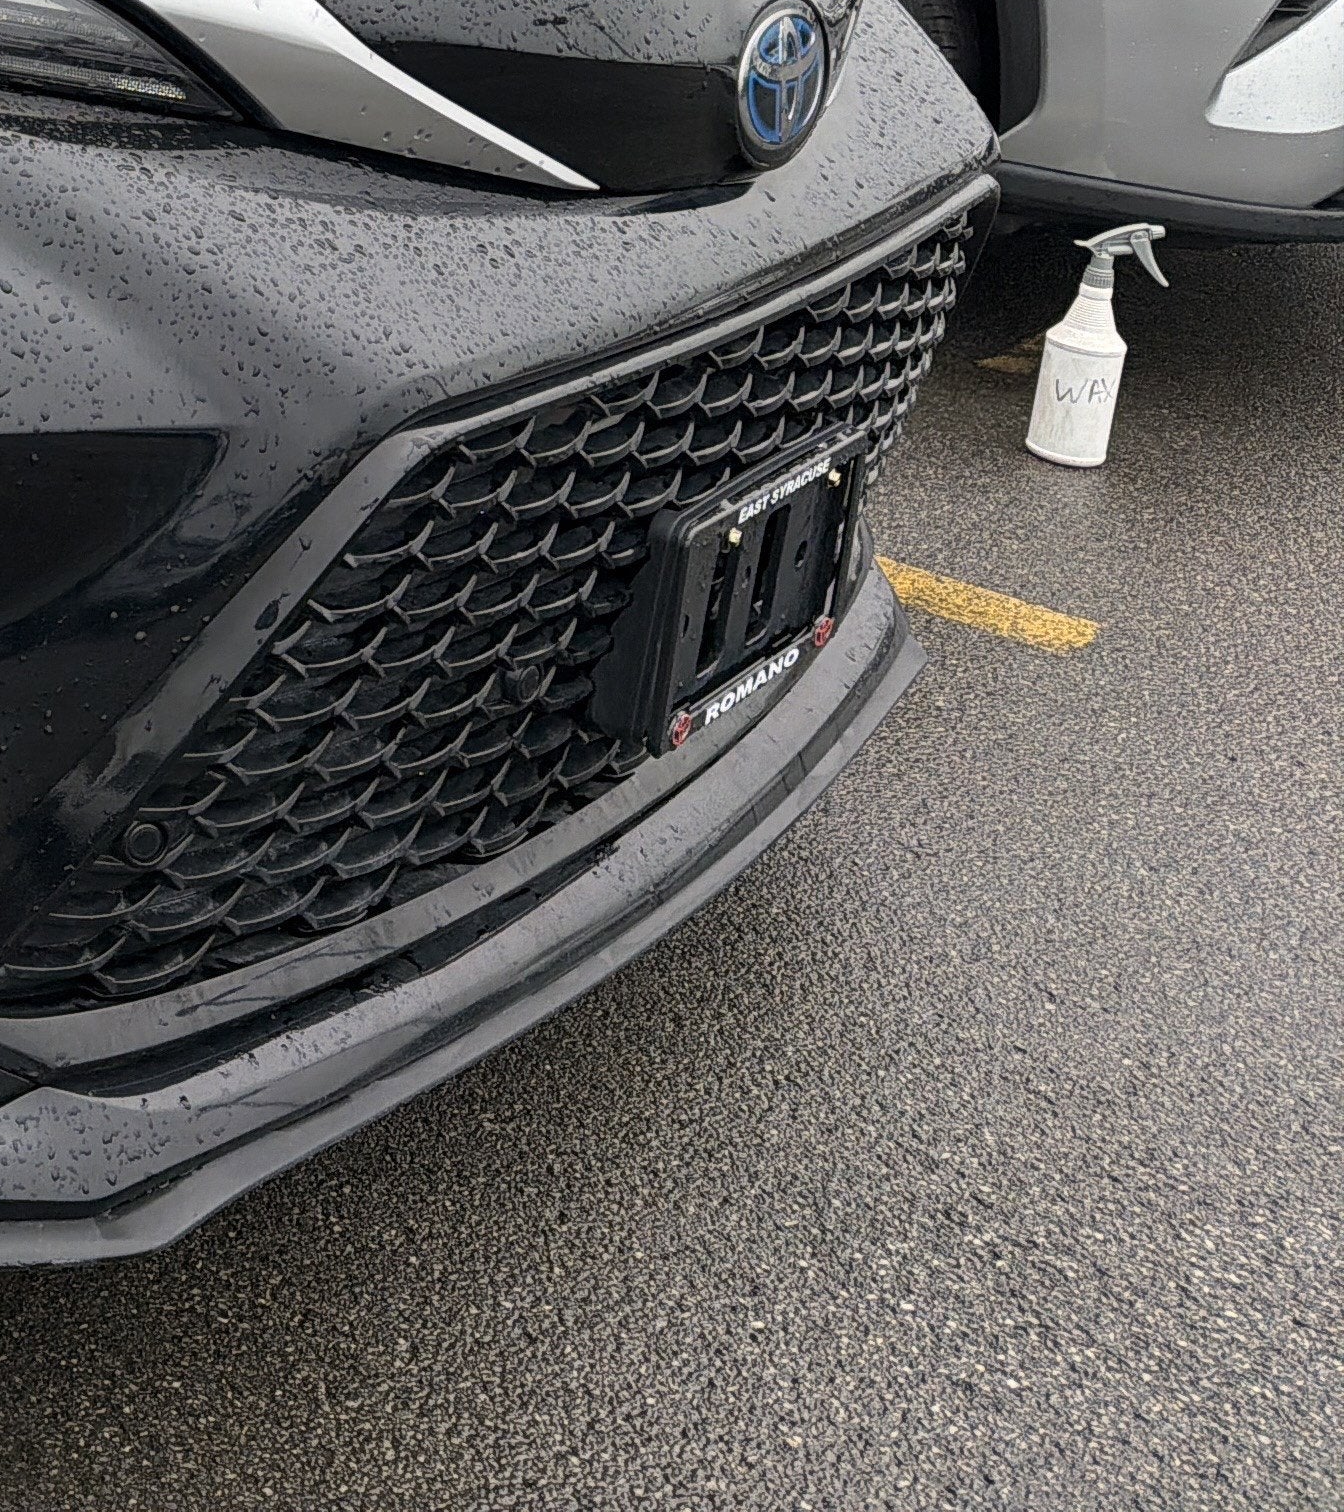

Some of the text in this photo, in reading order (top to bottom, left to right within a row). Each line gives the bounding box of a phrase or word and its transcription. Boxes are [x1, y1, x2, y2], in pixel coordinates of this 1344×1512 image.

[1055, 377, 1117, 405] WAX
[737, 456, 832, 526] EAST SYRACUSE
[704, 647, 801, 727] ROMANO
